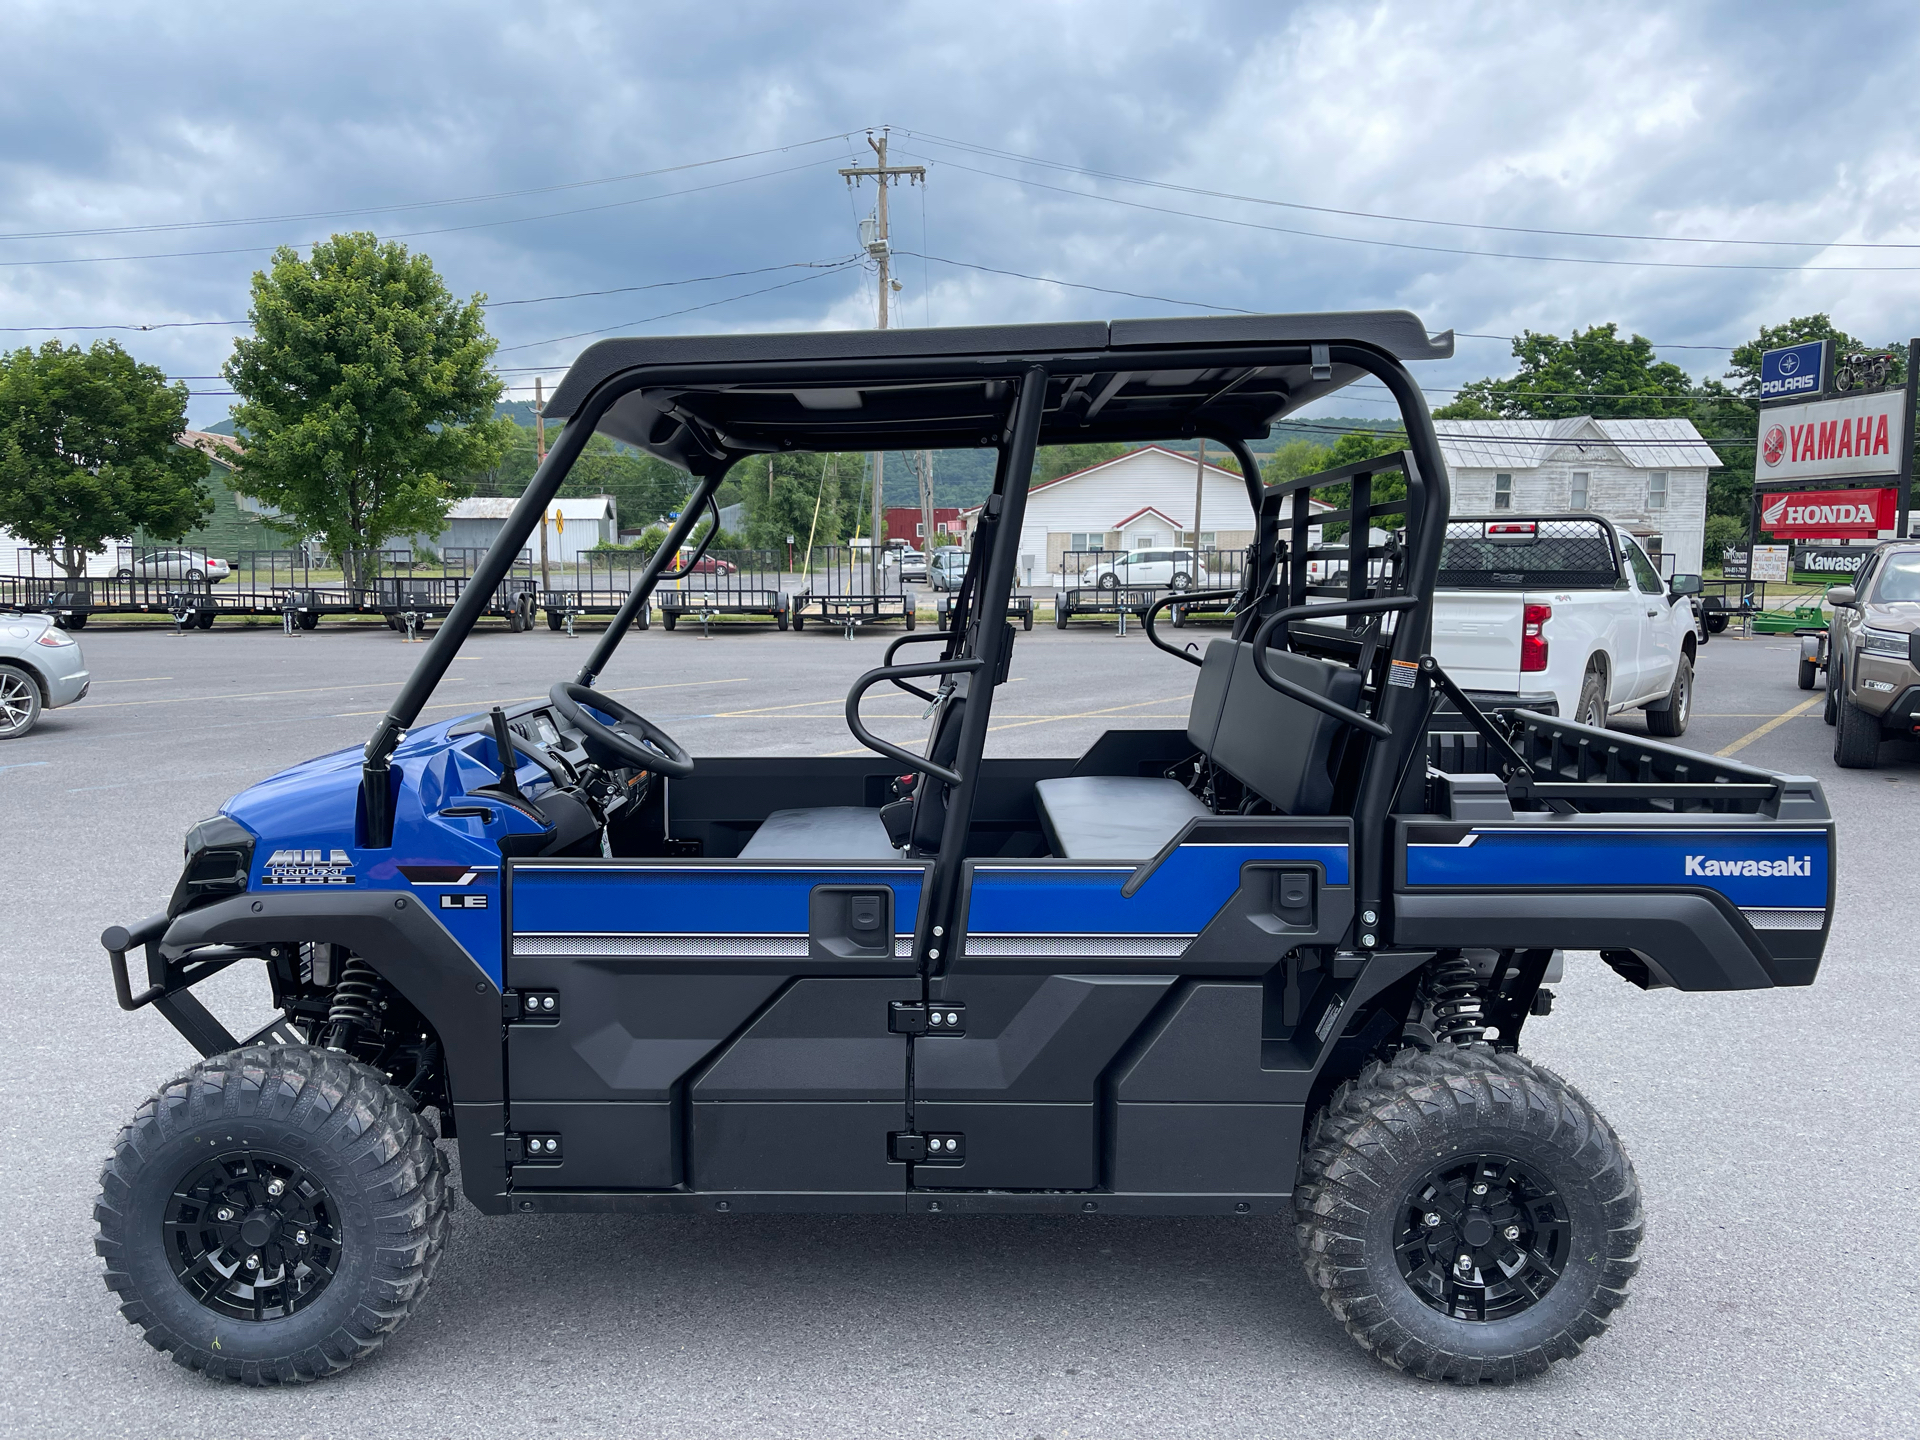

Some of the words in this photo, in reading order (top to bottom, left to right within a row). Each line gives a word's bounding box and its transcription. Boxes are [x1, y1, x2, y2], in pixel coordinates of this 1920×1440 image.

[1762, 374, 1814, 394] POLARIS
[1790, 414, 1889, 462] YAMAHA
[1786, 504, 1875, 524] HONDA
[1804, 552, 1867, 572] Kawasa
[264, 850, 354, 868] MULE
[1685, 855, 1811, 876] Kawasaki
[270, 876, 347, 884] 1000
[441, 895, 487, 908] LE
